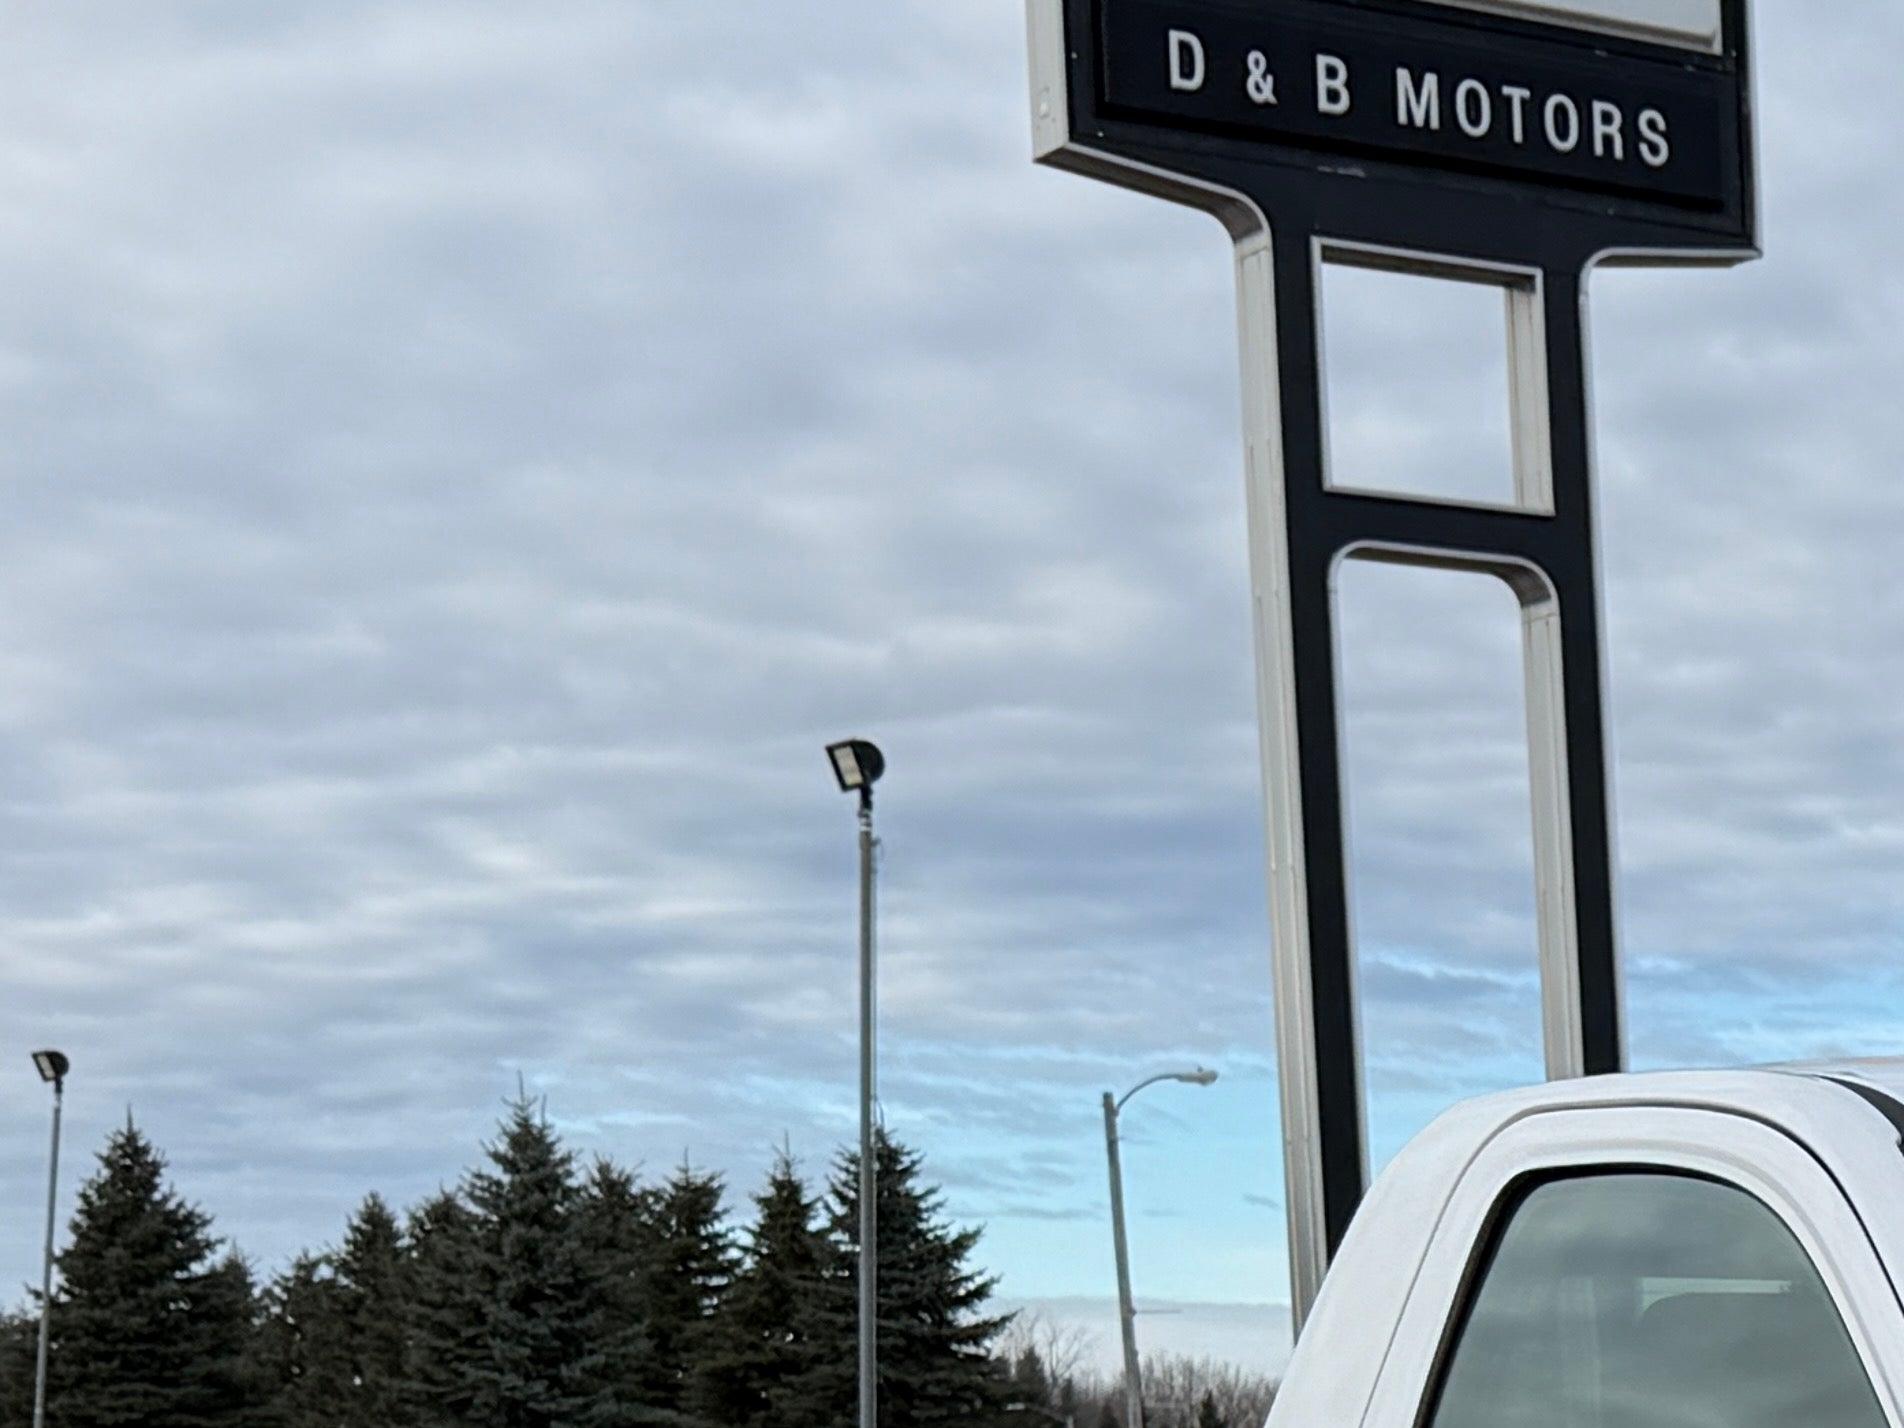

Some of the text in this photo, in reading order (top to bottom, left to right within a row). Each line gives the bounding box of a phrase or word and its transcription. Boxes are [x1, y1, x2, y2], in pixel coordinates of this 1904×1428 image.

[1167, 28, 1670, 168] D & B MOTORS
